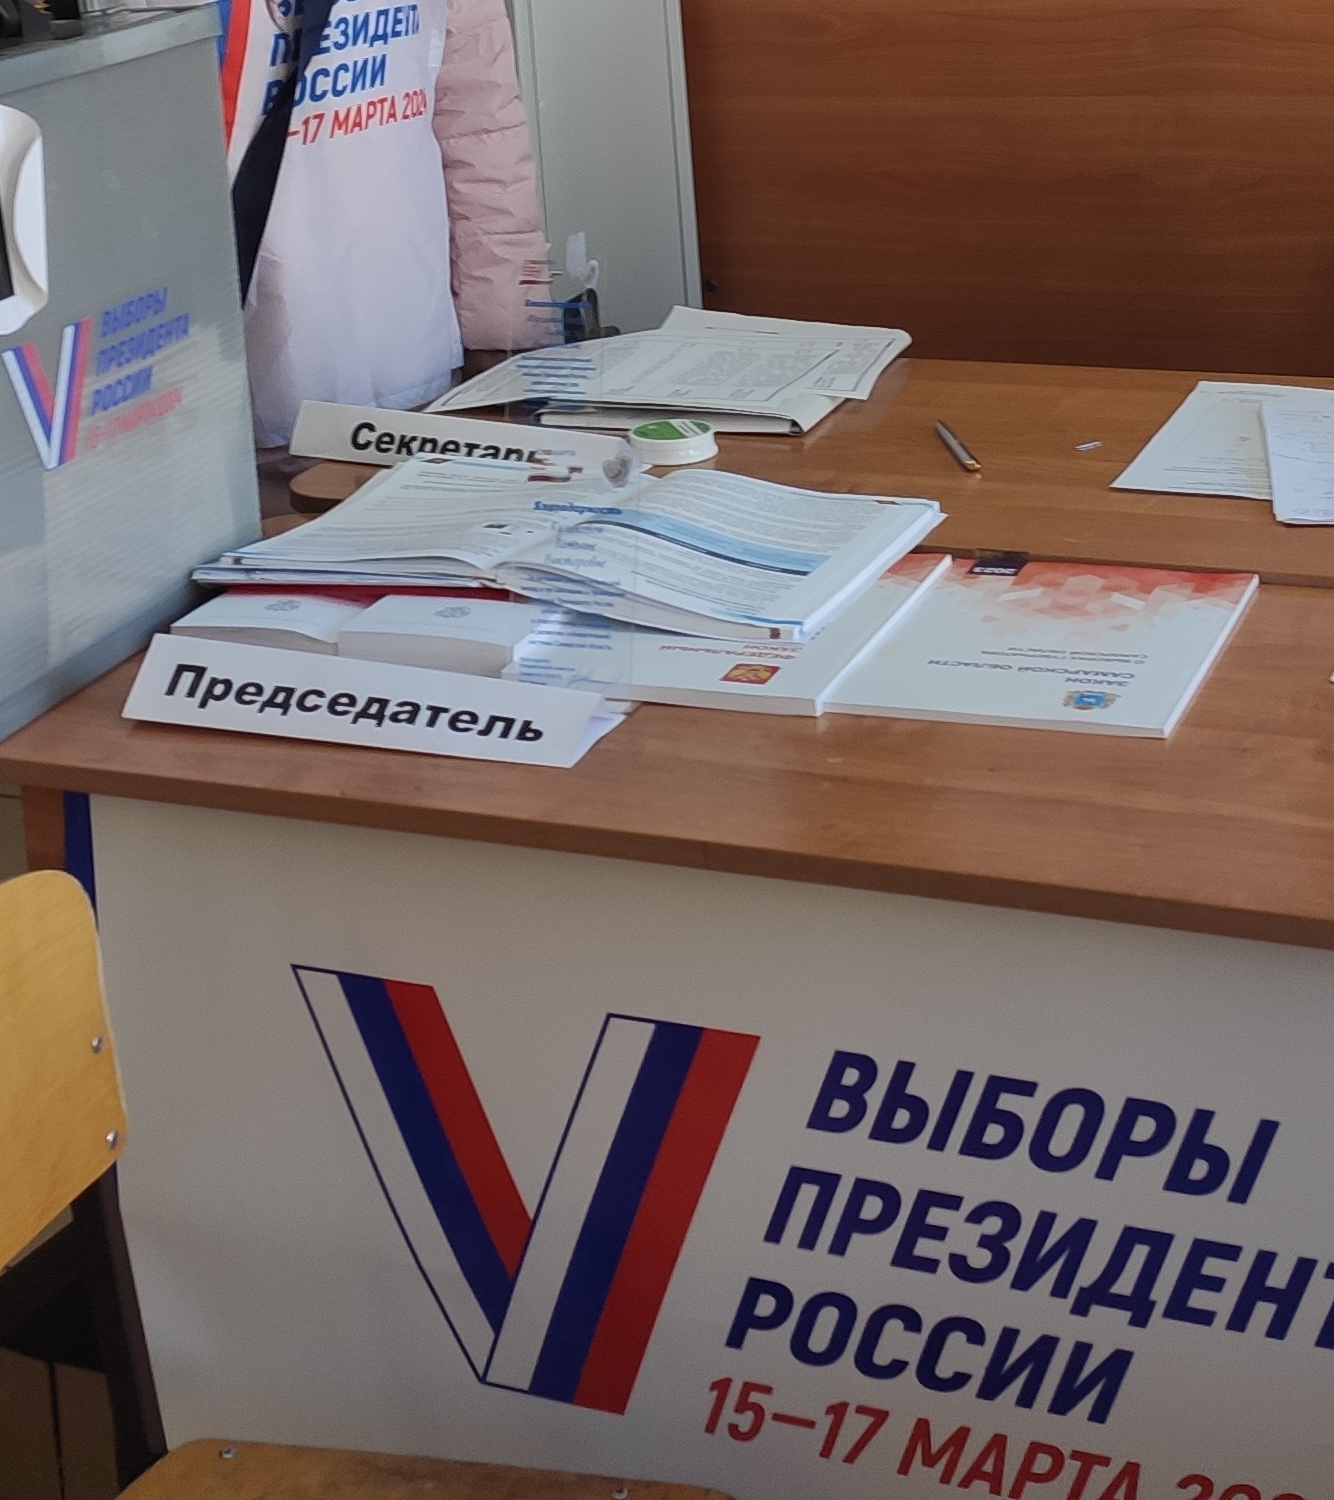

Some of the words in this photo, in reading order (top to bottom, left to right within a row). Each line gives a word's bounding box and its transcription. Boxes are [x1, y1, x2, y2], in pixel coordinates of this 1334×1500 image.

[329, 95, 397, 139] МАРТА
[165, 663, 544, 743] Председатель
[805, 1049, 1281, 1205] ВЫБОРЫ
[724, 1276, 1135, 1425] РОССИИ
[896, 1417, 1143, 1500] МАРТА
